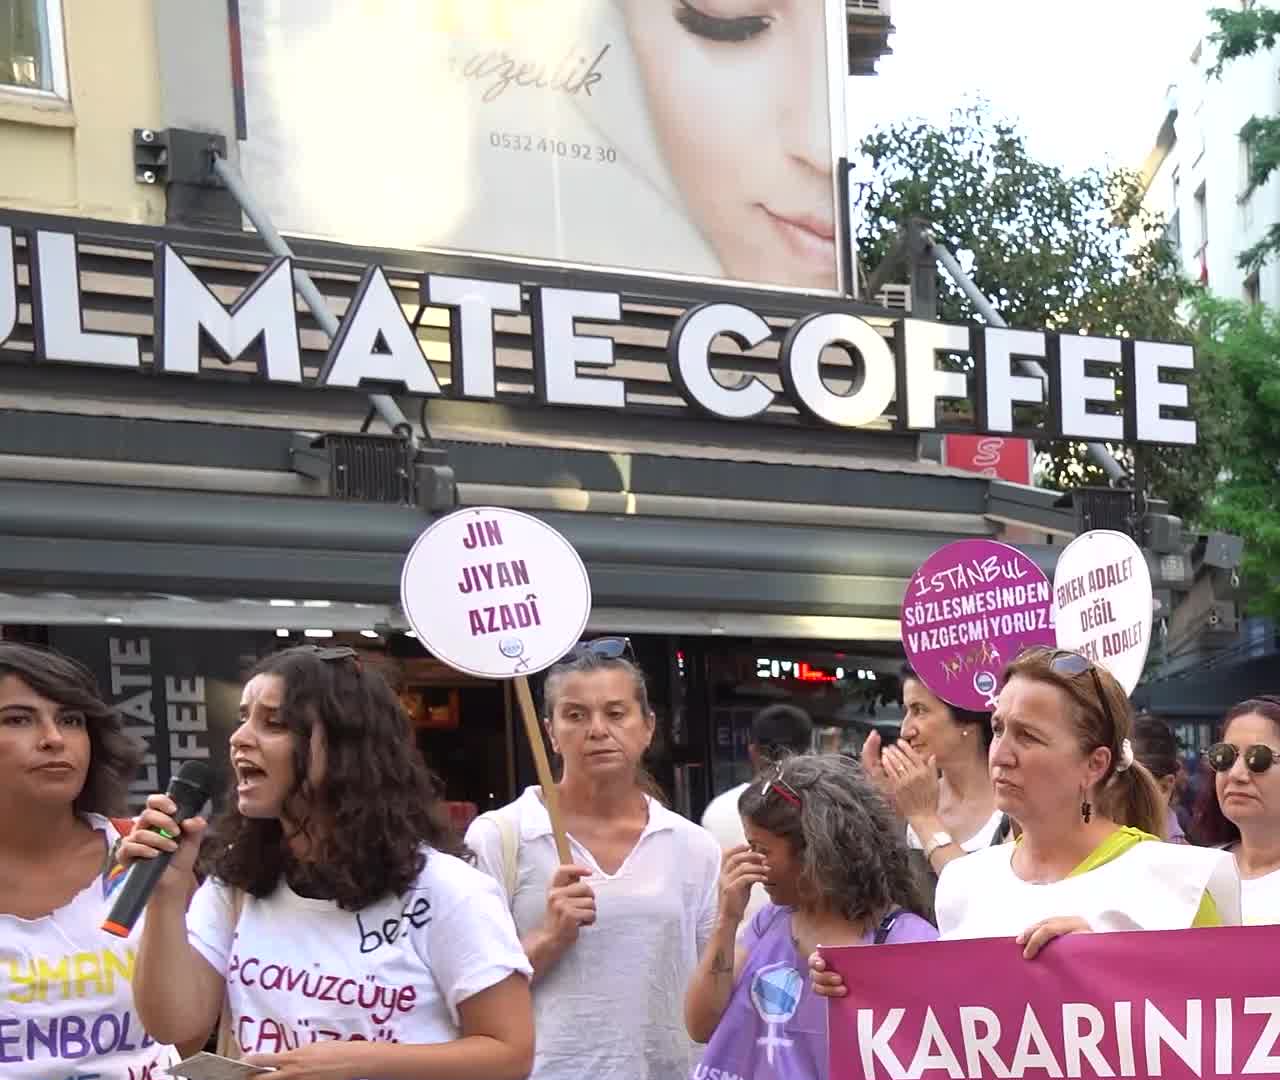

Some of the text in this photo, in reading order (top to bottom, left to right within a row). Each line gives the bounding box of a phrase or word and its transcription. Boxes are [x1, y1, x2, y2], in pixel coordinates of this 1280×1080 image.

[490, 131, 533, 152] 0532
[571, 143, 593, 161] 92
[598, 146, 617, 163] 30
[669, 302, 1196, 444] COFFEE
[463, 520, 504, 549] JIN
[457, 560, 530, 594] JIYAN
[914, 555, 1029, 598] İSTANBUL
[1088, 556, 1134, 591] ADALET
[468, 594, 542, 636] AZADÎ
[904, 581, 1050, 628] SÖZLEŞMESİNDEN
[1080, 598, 1117, 633] DEĞİL
[1101, 620, 1143, 658] ADALET
